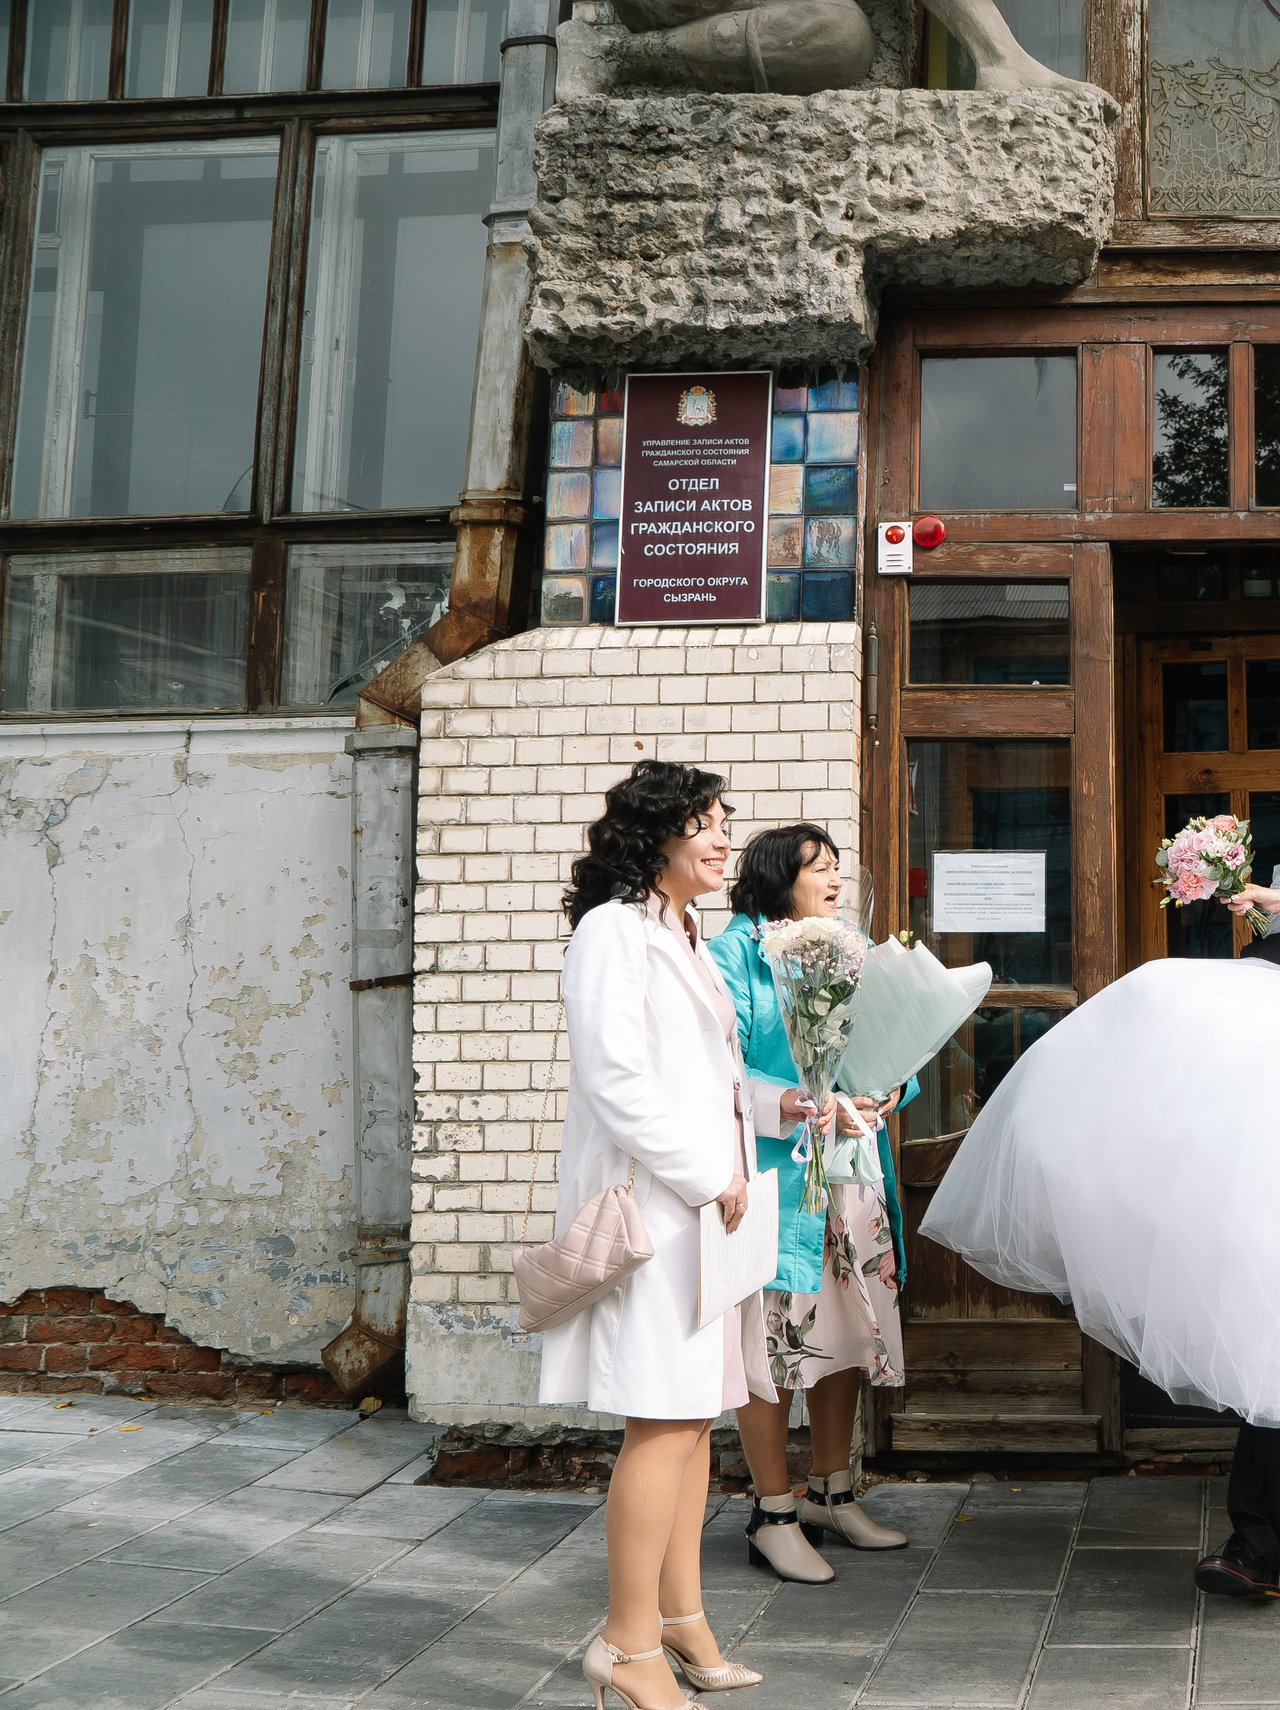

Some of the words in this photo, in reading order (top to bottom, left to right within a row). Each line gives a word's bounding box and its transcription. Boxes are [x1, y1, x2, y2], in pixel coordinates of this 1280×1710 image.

[642, 439, 690, 447] УПРАВЛЕНИЕ
[642, 449, 701, 457] ГРАЖДАНСКОГО
[653, 458, 699, 467] САМАРСКОЙ
[668, 478, 719, 492] ОТДЕЛ
[634, 500, 696, 513] ЗАПИСИ
[700, 499, 753, 511] АКТОВ
[630, 520, 755, 535] ГРАЖДАНСКОГО
[643, 542, 739, 556] СОСТОЯНИЯ
[633, 578, 705, 589] ГОРОДСКОГО
[707, 577, 749, 586] ОКРУГА
[663, 593, 717, 603] СЫЗРАНЬ
